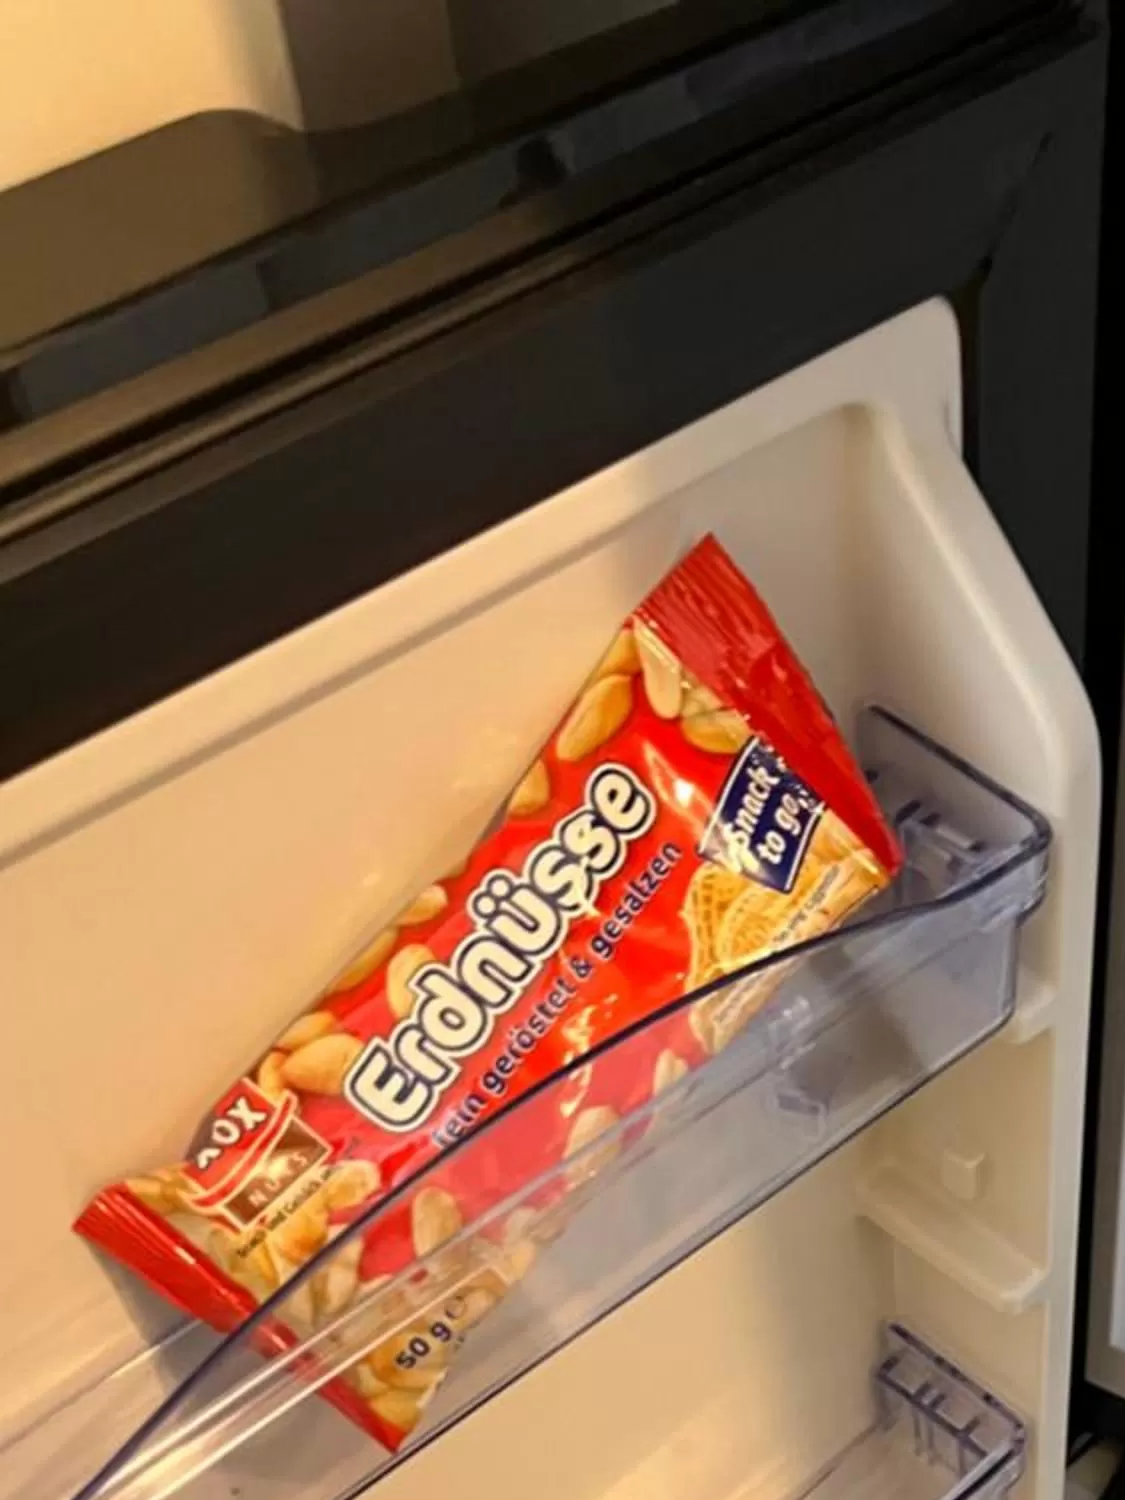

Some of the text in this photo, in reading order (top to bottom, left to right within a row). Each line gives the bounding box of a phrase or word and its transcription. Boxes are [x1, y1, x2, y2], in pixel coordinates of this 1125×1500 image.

[725, 766, 780, 852] Snack
[757, 829, 787, 866] to
[347, 764, 654, 1130] Erdnüsse
[484, 976, 575, 1095] geröstet
[572, 957, 592, 979] &
[593, 841, 682, 961] gesalzen
[248, 1151, 308, 1208] NUS
[396, 1320, 452, 1369] 50 g
